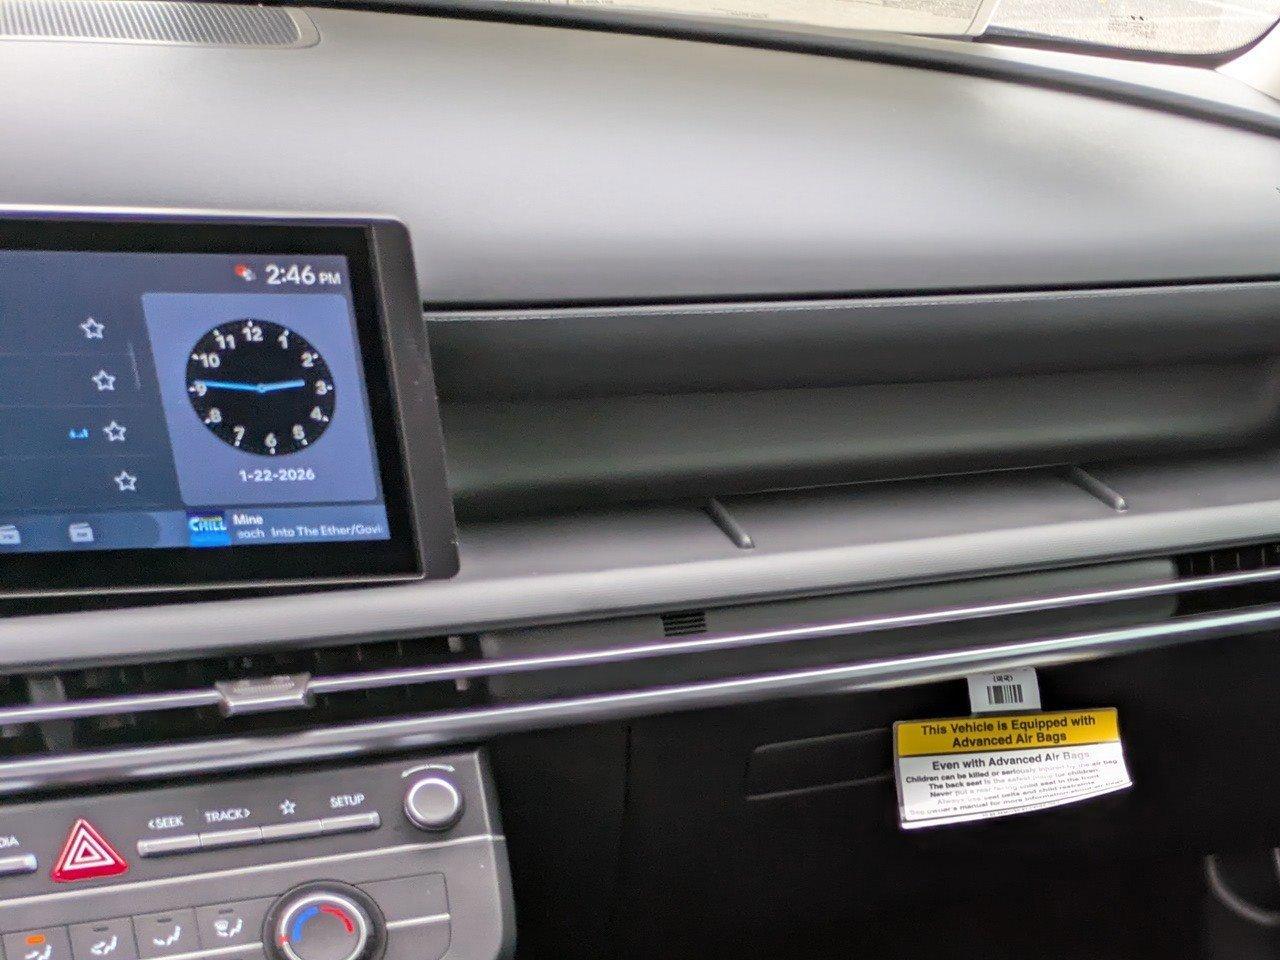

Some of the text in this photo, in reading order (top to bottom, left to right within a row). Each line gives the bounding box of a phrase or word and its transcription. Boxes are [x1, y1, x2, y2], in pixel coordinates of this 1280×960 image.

[265, 264, 342, 286] 2:46 PM
[215, 334, 236, 350] 11
[242, 326, 264, 342] 12
[277, 334, 289, 349] 1
[199, 352, 221, 368] 10
[301, 352, 314, 368] 2
[315, 380, 328, 396] 3
[310, 405, 323, 421] 4
[233, 425, 245, 440] 7
[264, 432, 277, 448] 6
[292, 424, 305, 440] 5
[238, 469, 316, 483] 1-22-2026
[189, 516, 227, 532] CHILL
[232, 514, 264, 526] Mine
[271, 526, 296, 538] Into
[298, 526, 318, 537] The
[921, 715, 1096, 736] This Vehicle is Equipped with
[952, 732, 1067, 748] Advanced Air Bags
[932, 752, 1090, 771] Even with Advanced Air Bags
[905, 775, 939, 784] Children
[957, 772, 967, 780] be
[968, 771, 990, 779] killed
[929, 782, 944, 790] The
[945, 780, 965, 788] back
[329, 793, 365, 809] SETUP
[929, 790, 953, 798] Never
